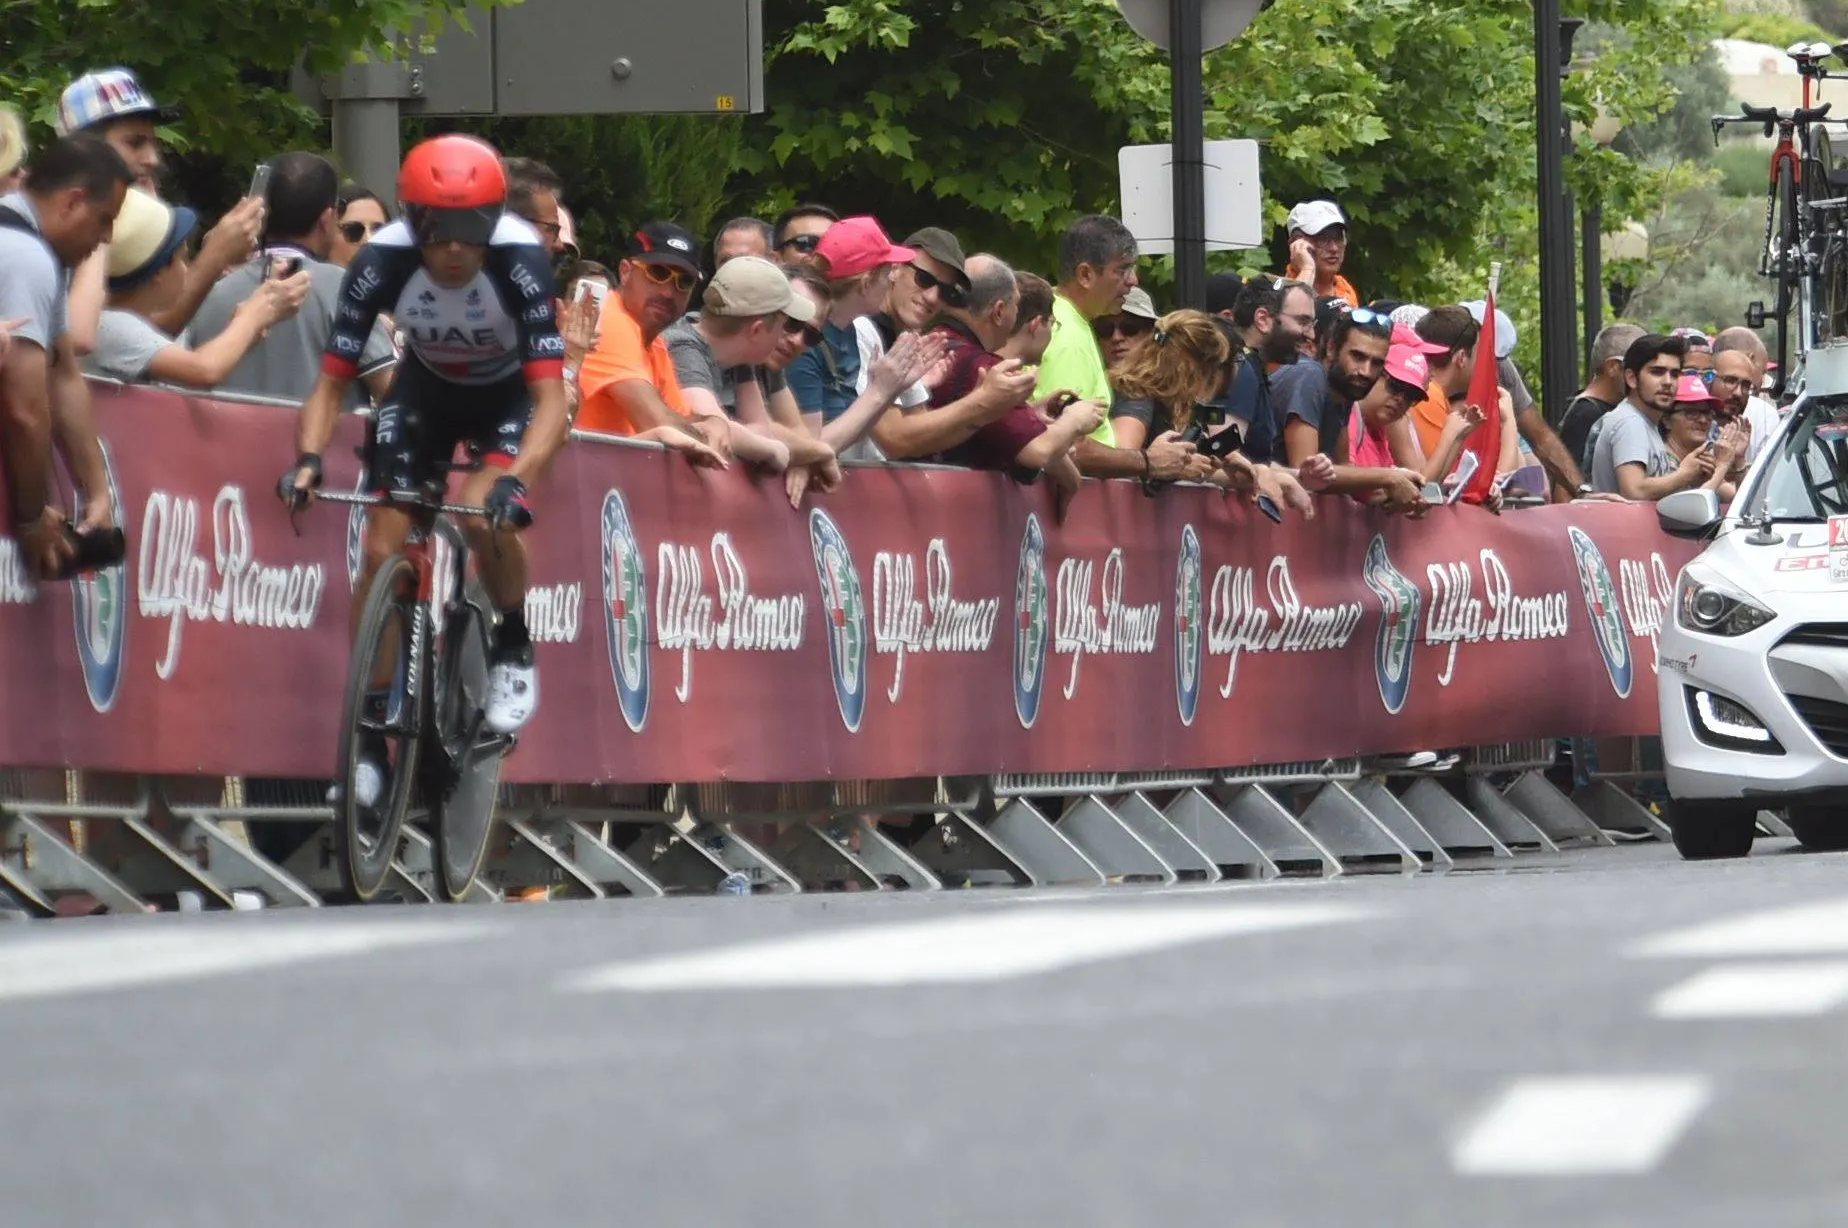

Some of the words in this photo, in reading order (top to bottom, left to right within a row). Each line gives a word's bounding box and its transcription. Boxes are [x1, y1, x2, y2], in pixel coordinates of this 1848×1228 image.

[350, 266, 382, 301] UAE
[409, 325, 500, 346] UAE
[509, 264, 540, 299] UAE
[138, 491, 212, 680] Alfa
[210, 485, 321, 629] Romeo
[656, 542, 714, 703] Alfa
[711, 532, 803, 651] Romeo
[873, 552, 924, 703] Alfa
[922, 538, 999, 652] Romeo
[1055, 557, 1101, 700] Alfa
[1099, 547, 1160, 654] Romeo
[1208, 565, 1269, 699] Alfa
[1266, 555, 1363, 653] Romeo
[1426, 562, 1484, 687] Alfa
[1480, 548, 1569, 642] Romeo
